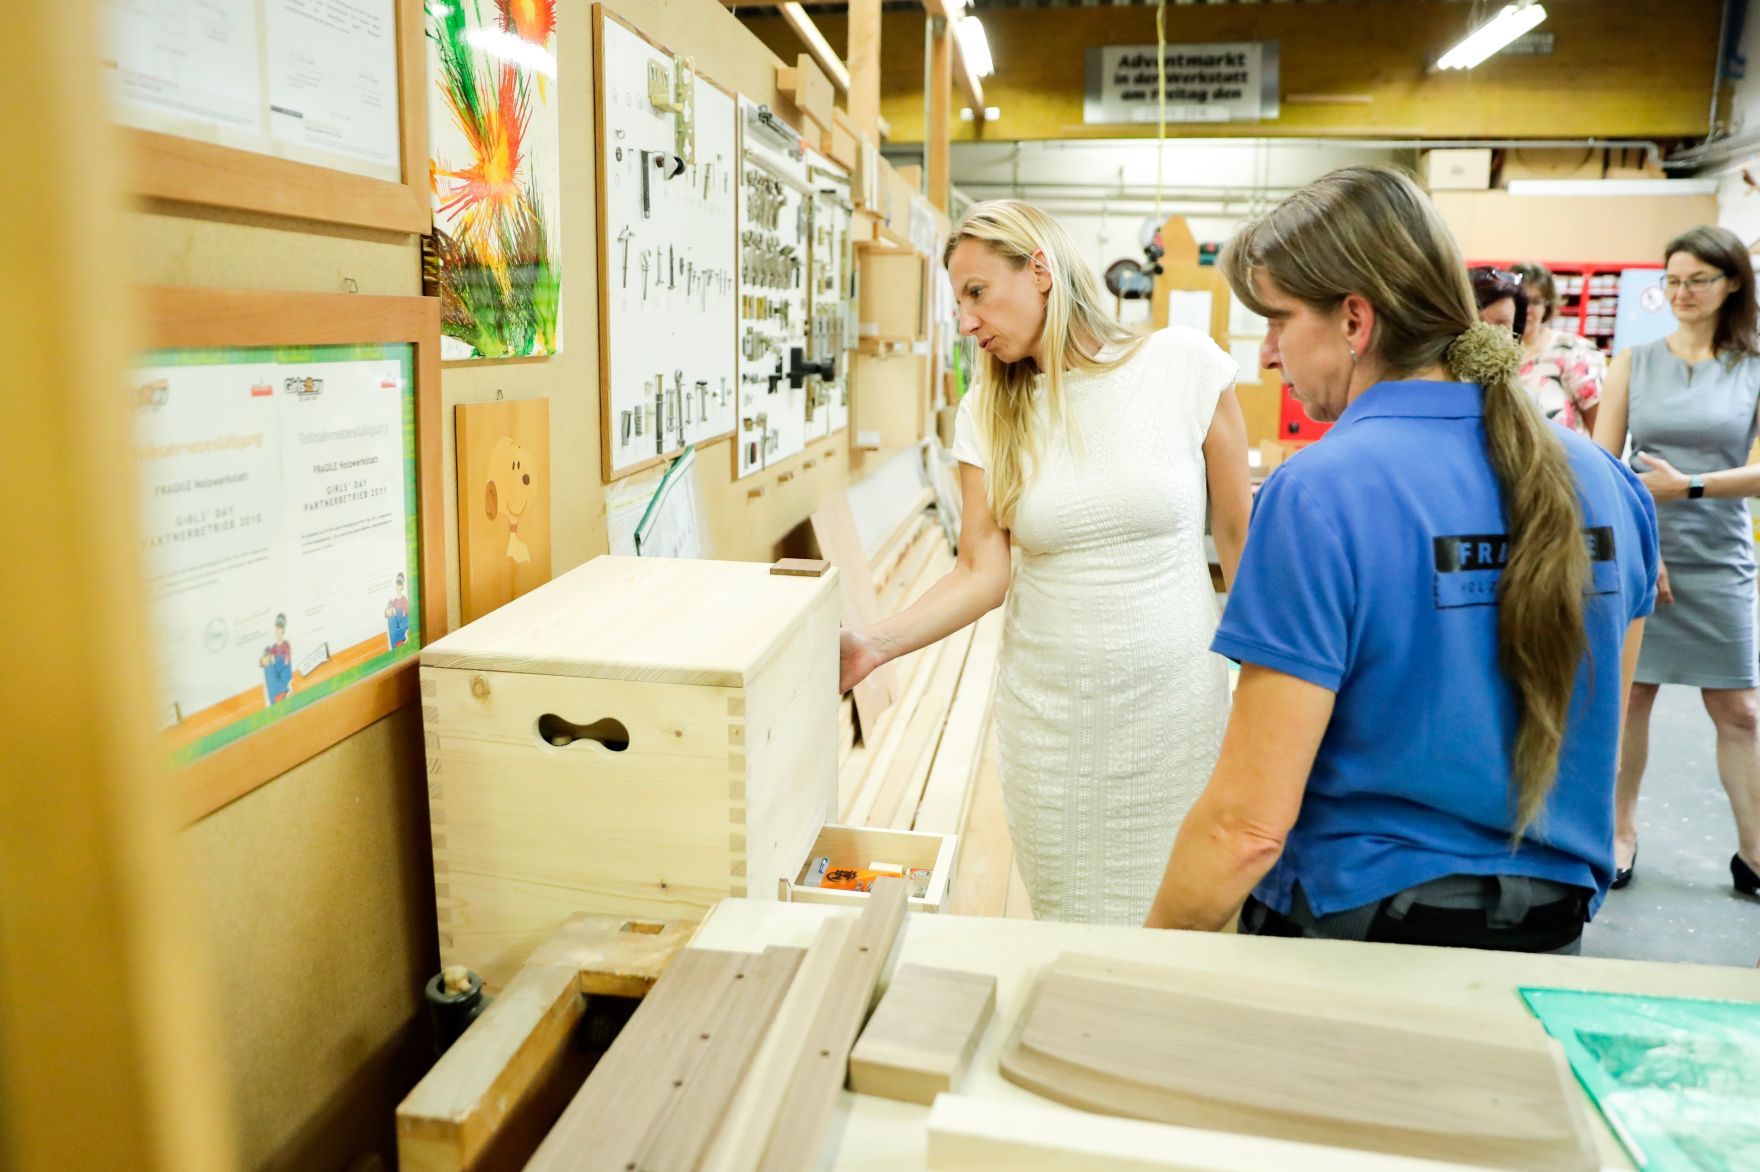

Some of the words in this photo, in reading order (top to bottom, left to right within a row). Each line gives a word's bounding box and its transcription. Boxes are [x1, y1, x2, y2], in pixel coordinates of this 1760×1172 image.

[1118, 52, 1246, 68] Advntmarkt
[1120, 89, 1146, 101] am
[1150, 87, 1208, 104] Feitag
[1212, 86, 1242, 99] den
[353, 479, 367, 489] DAY
